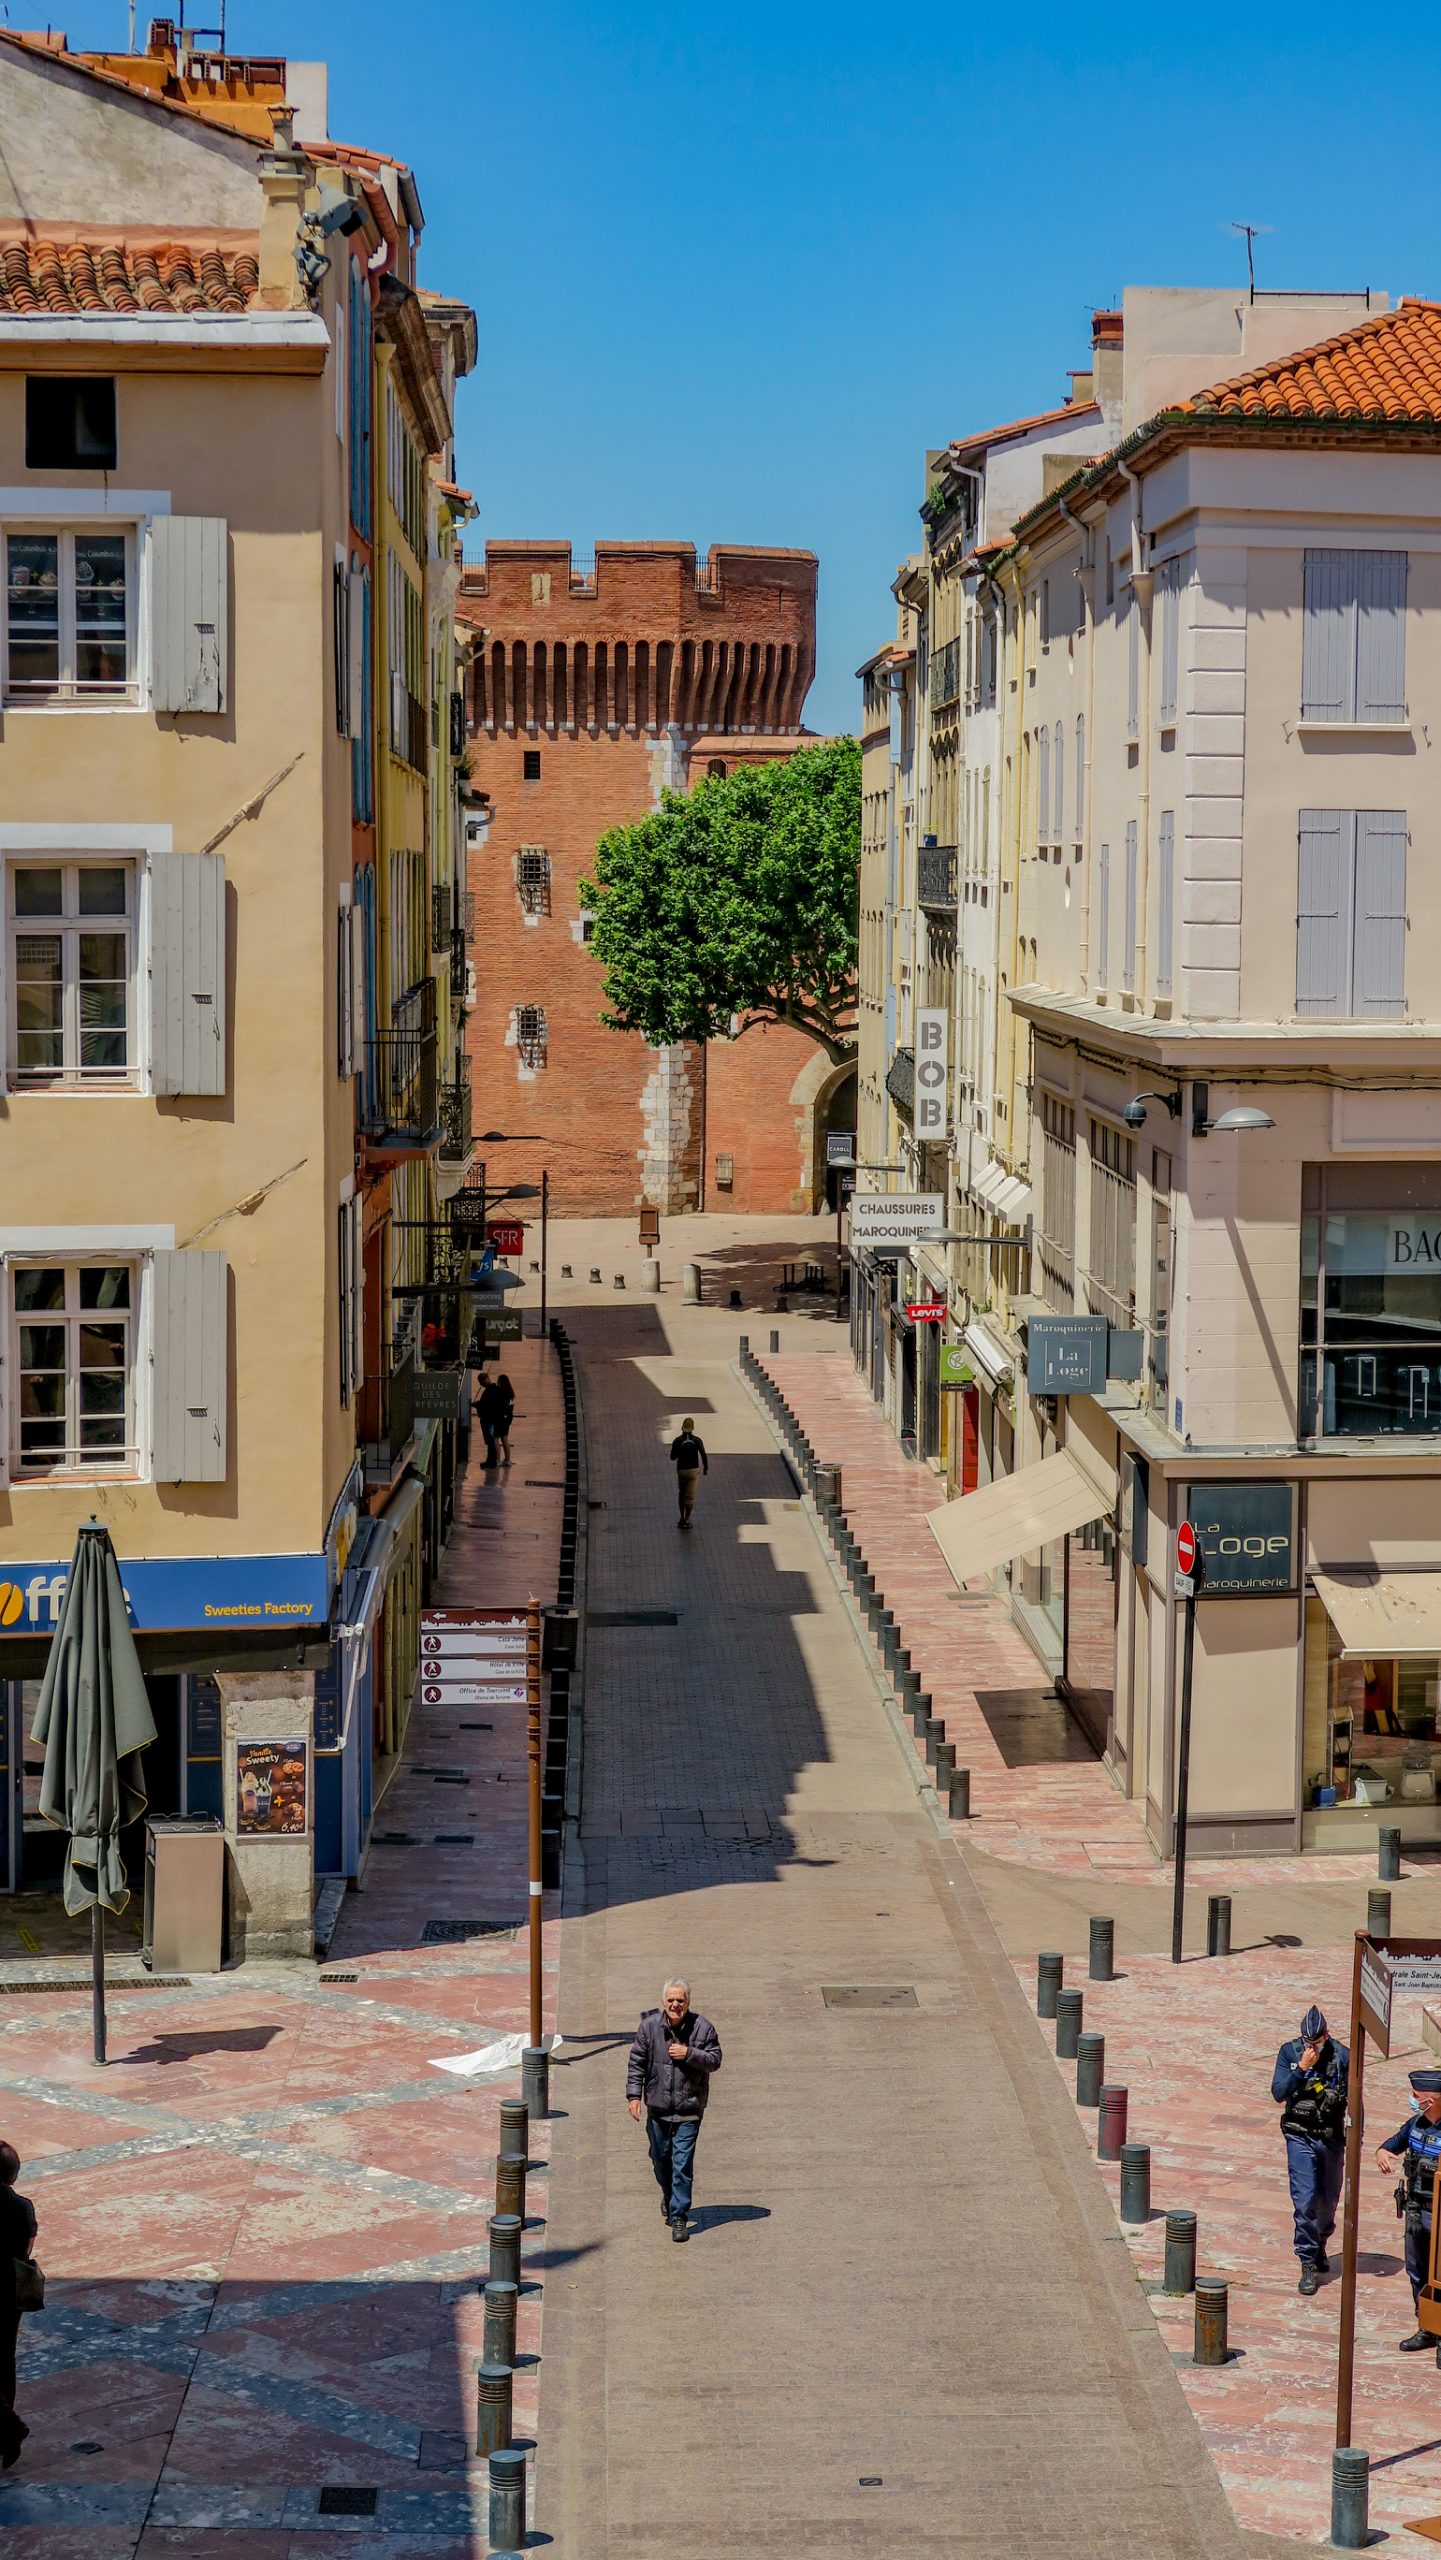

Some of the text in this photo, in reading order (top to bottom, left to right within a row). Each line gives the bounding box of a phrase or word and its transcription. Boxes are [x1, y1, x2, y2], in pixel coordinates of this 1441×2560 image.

[918, 1022, 945, 1127] BOB
[859, 1204, 936, 1215] CHAUSSURES
[492, 1230, 518, 1246] SFR
[852, 1226, 931, 1238] MAROQUINE
[1033, 1323, 1105, 1334] Maroquinerie
[1058, 1347, 1079, 1361] La
[1048, 1362, 1089, 1378] Loge
[1194, 1521, 1221, 1533] La
[1203, 1577, 1288, 1590] aroquinerie
[204, 1601, 313, 1617] Sweeties Factory
[246, 1754, 280, 1766] Sweety
